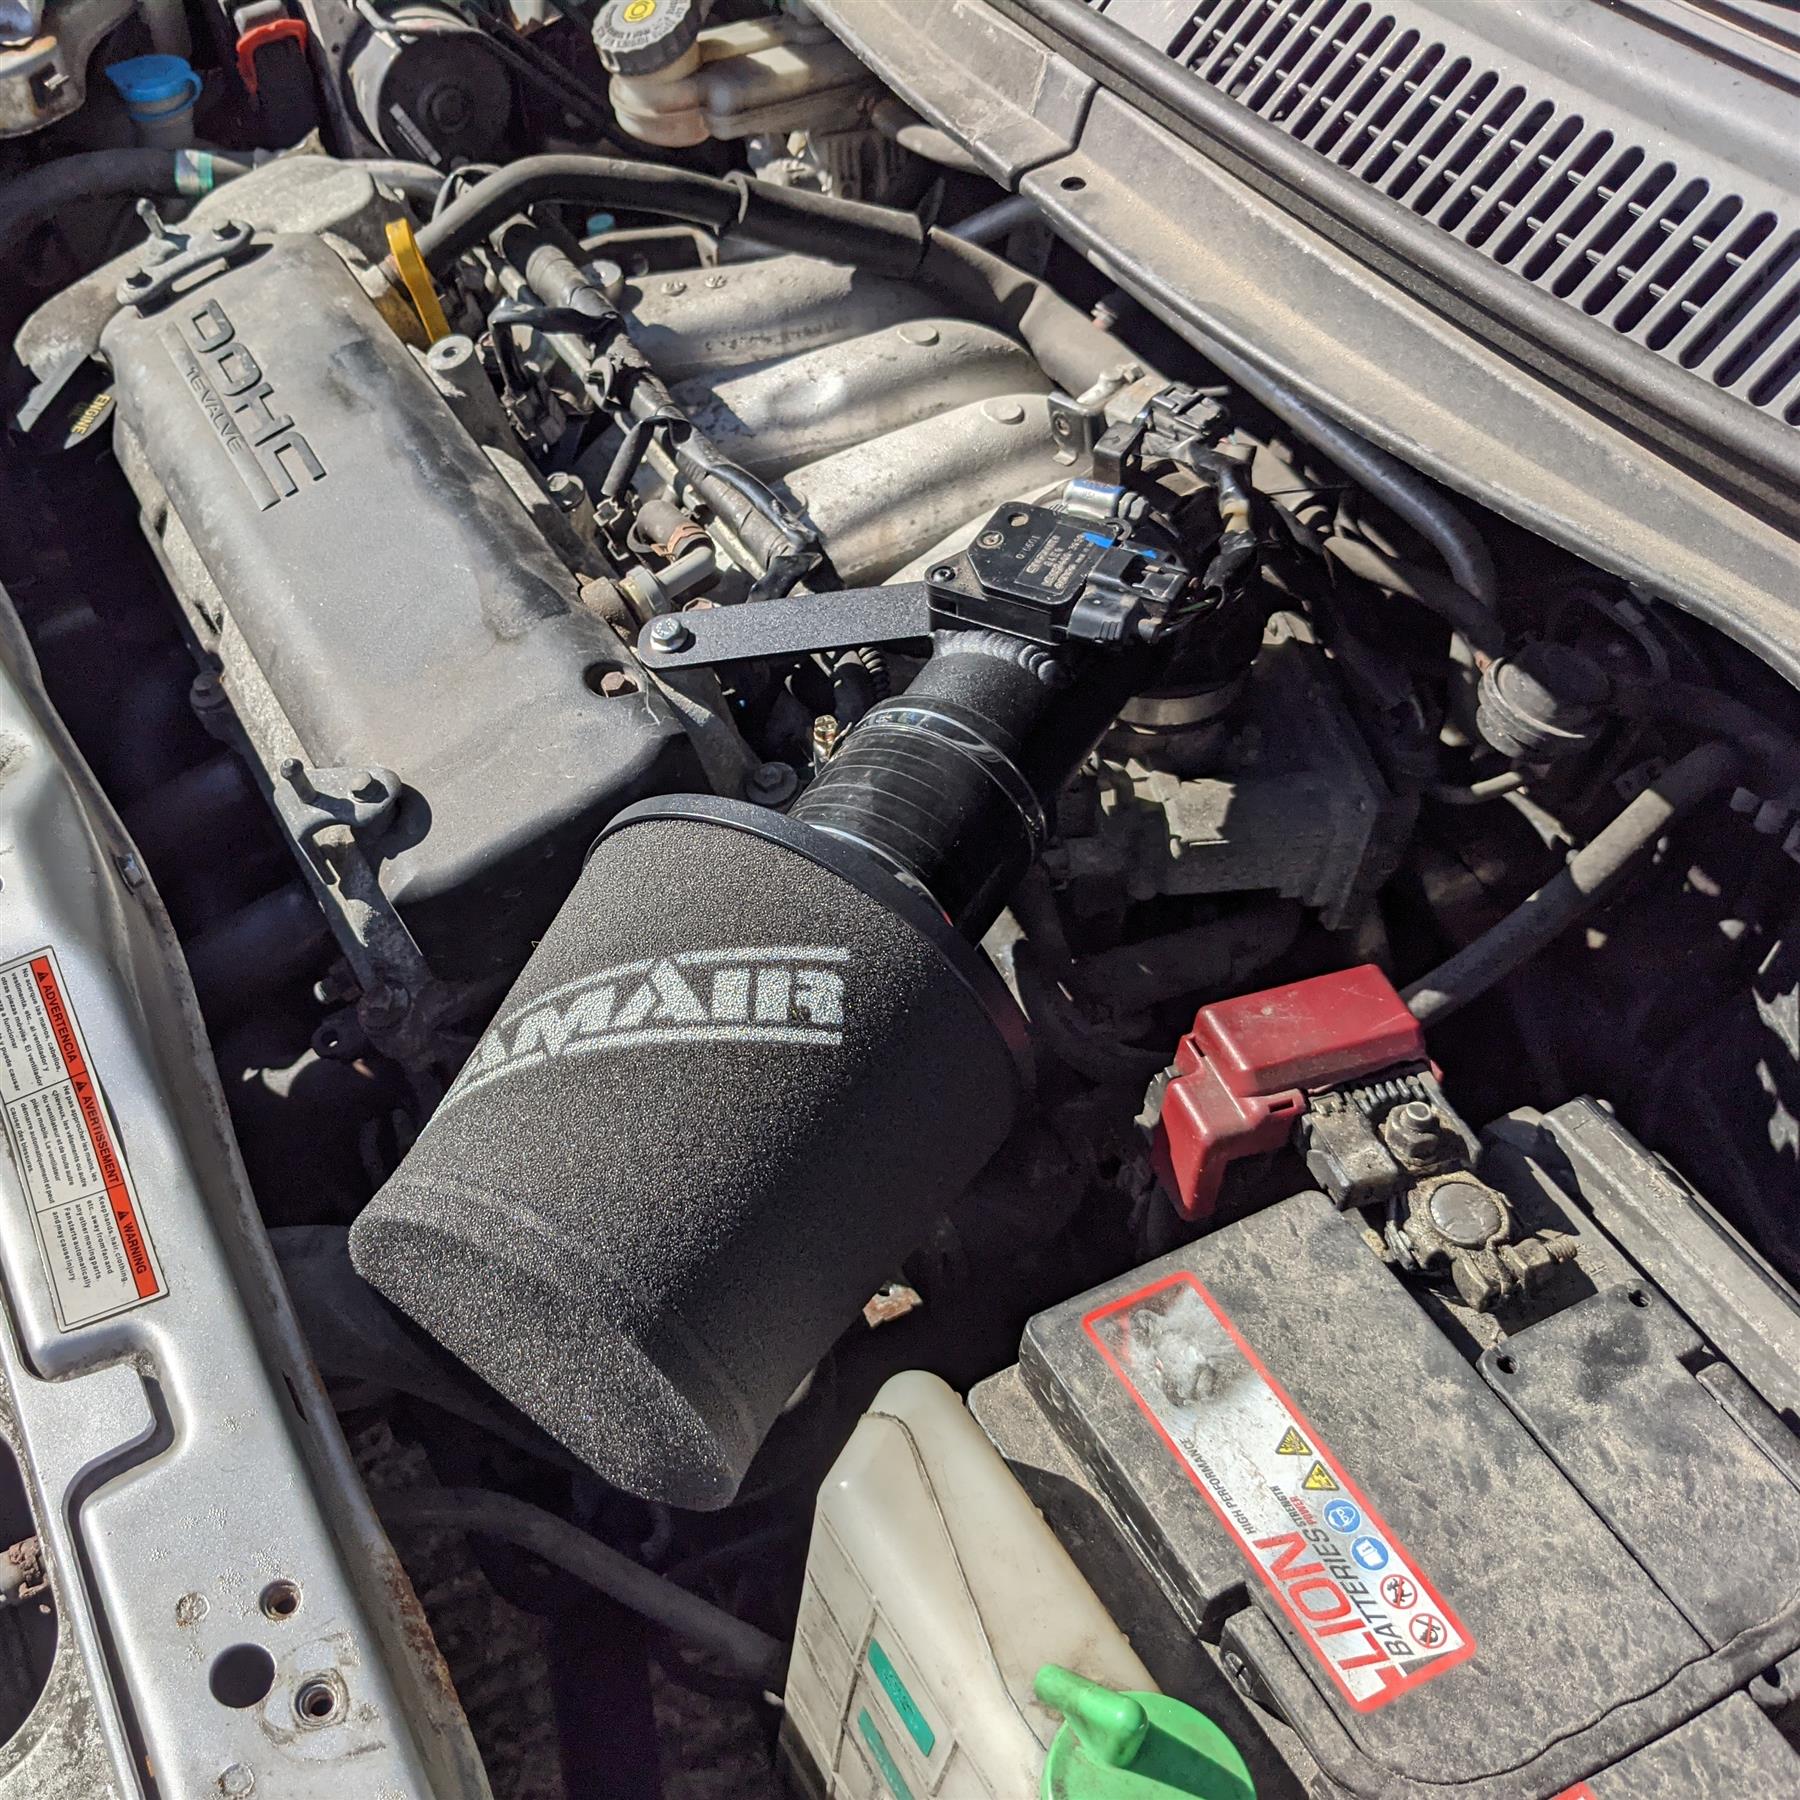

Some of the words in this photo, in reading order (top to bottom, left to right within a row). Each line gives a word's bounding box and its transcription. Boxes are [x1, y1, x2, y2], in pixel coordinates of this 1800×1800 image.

[190, 298, 327, 497] DOHC
[70, 392, 112, 434] ENGINE
[22, 967, 29, 978] No
[1, 976, 10, 994] otras
[25, 979, 38, 1005] acerque
[5, 994, 18, 1016] piezas
[466, 958, 846, 1066] AMAIR
[11, 972, 27, 1010] vestimenta,
[32, 1032, 48, 1066] ventilador
[14, 1016, 27, 1044] móviles.
[38, 1016, 50, 1042] manos,
[43, 985, 77, 1063] ADVERTENCIA
[3, 1017, 18, 1049] funcionar
[24, 1044, 32, 1053] El
[47, 1042, 61, 1073] cabellos,
[0, 1046, 12, 1068] puede
[8, 1068, 21, 1091] causar
[27, 1053, 43, 1086] ventilador
[41, 1094, 49, 1104] du
[62, 1085, 71, 1096] Ne
[65, 1095, 74, 1109] pas
[29, 1098, 41, 1117] pièce
[51, 1089, 66, 1120] cheveux,
[9, 1107, 21, 1129] causer
[37, 1117, 49, 1140] mobile.
[45, 1104, 60, 1138] ventilateur
[62, 1119, 70, 1131] les
[70, 1109, 86, 1142] approcher
[17, 1130, 25, 1142] des
[44, 1140, 52, 1150] Le
[66, 1130, 80, 1163] vêtements
[82, 1096, 119, 1182] AVERTISSEMENT
[20, 1102, 33, 1130] démarre
[29, 1130, 49, 1183] automatiquement
[45, 1189, 55, 1204] peut
[20, 1141, 33, 1173] blessures.
[58, 1145, 65, 1154] de
[47, 1150, 61, 1181] ventilateur
[60, 1153, 70, 1170] toute
[75, 1163, 82, 1172] ou
[84, 1151, 95, 1173] mains,
[65, 1170, 74, 1186] autre
[78, 1171, 87, 1188] autre
[52, 1211, 62, 1225] and
[63, 1207, 72, 1221] Fan
[75, 1203, 83, 1216] any
[55, 1224, 65, 1239] may
[67, 1220, 78, 1241] starts
[78, 1216, 89, 1234] other
[91, 1215, 100, 1232] away
[98, 1195, 108, 1214] Keep
[103, 1212, 114, 1237] hands,
[110, 1236, 119, 1253] hair,
[59, 1238, 70, 1260] cause
[84, 1234, 96, 1261] moving
[96, 1232, 106, 1249] from
[123, 1222, 147, 1274] WARNING
[73, 1241, 91, 1288] automatically
[101, 1248, 109, 1261] fan
[65, 1259, 76, 1282] injury.
[90, 1260, 102, 1281] parts.
[104, 1260, 114, 1275] and
[1178, 1437, 1238, 1510] PERFORMANCE
[1269, 1485, 1308, 1527] STRENGTH
[1288, 1494, 1318, 1525] POWER
[1230, 1508, 1257, 1535] HIGH
[1252, 1531, 1391, 1670] LION
[1303, 1527, 1415, 1657] BATTERIES
